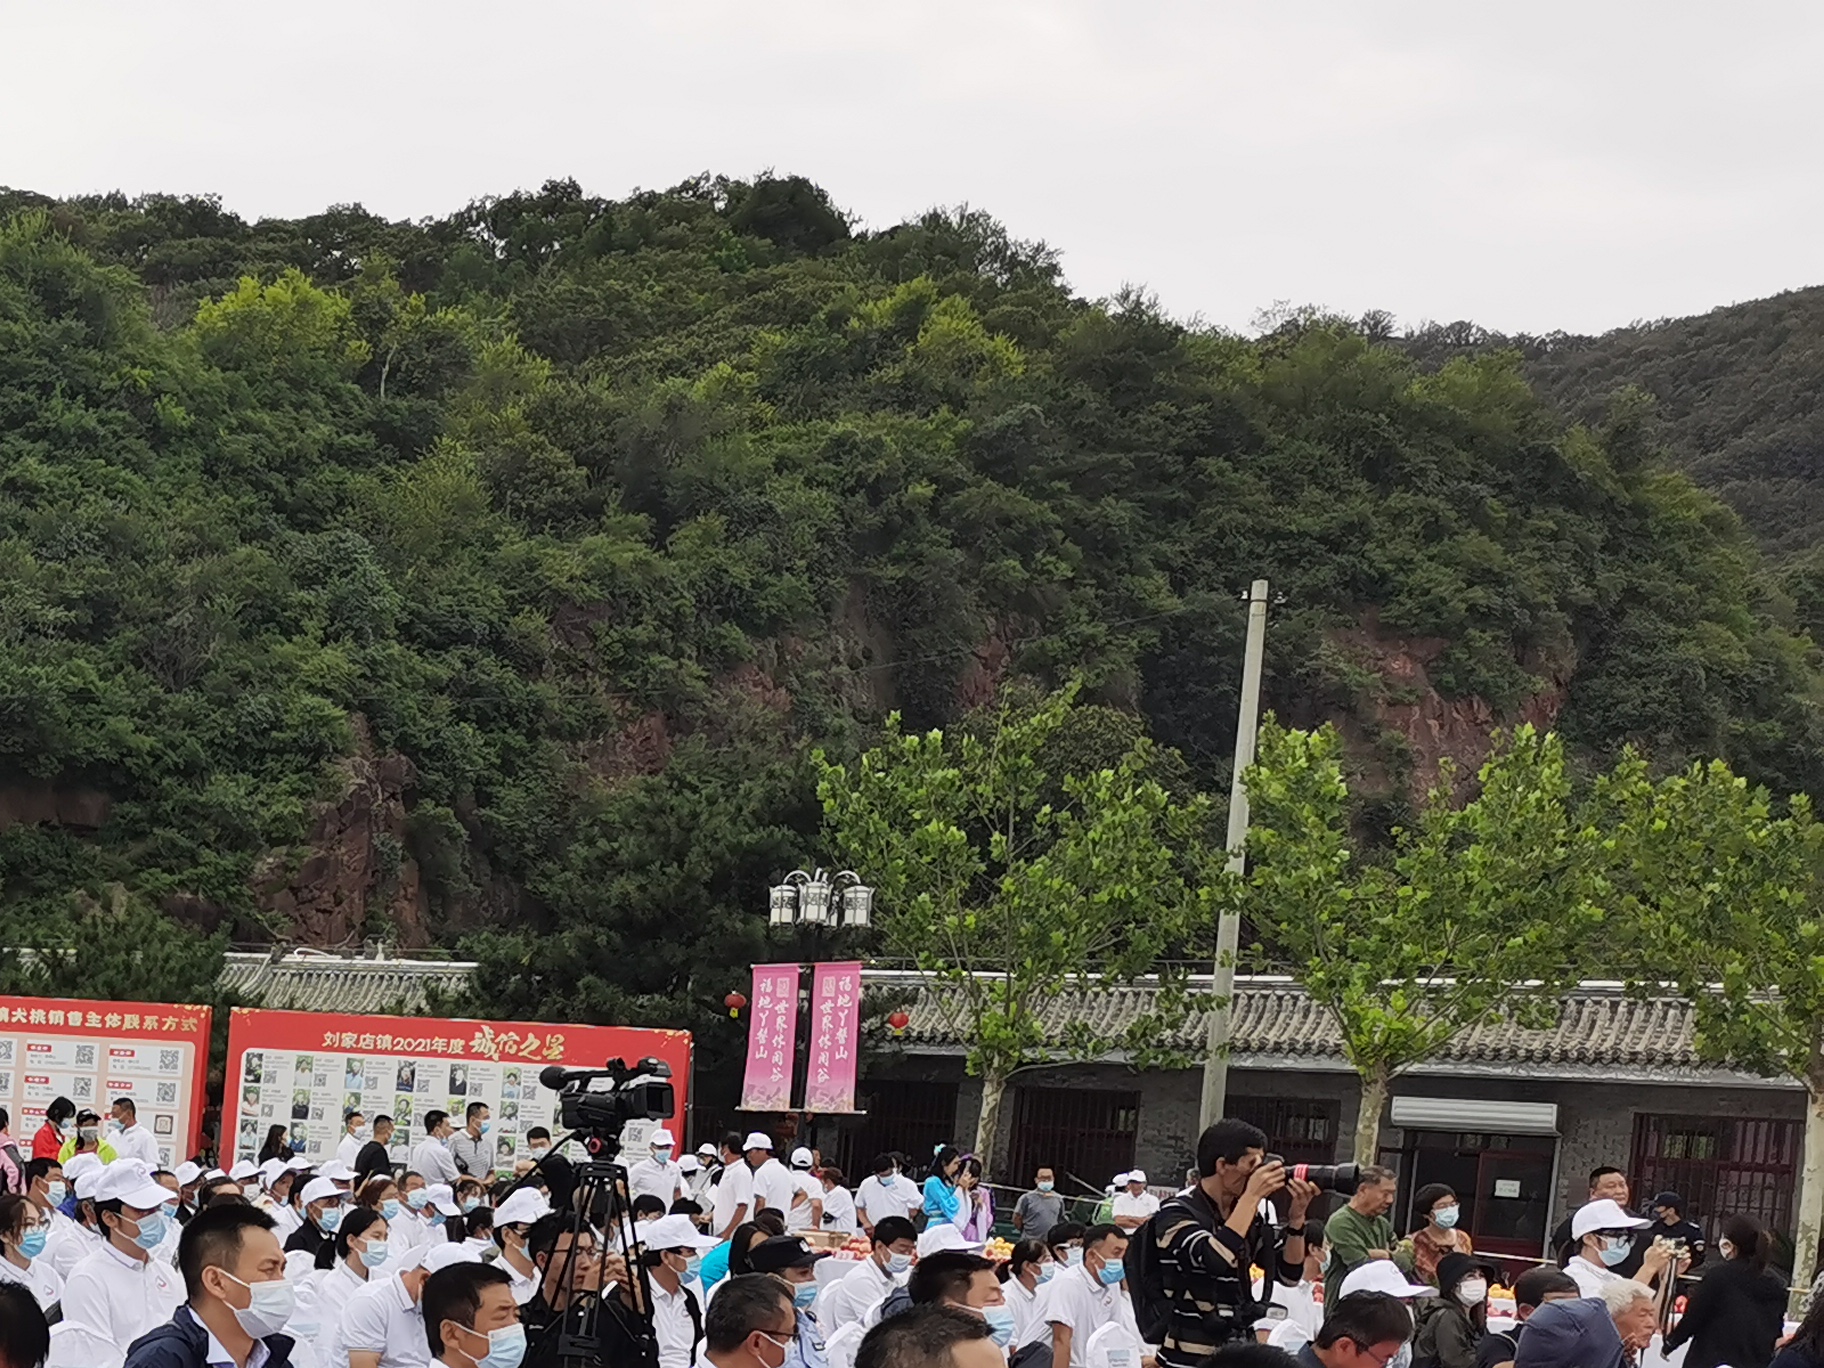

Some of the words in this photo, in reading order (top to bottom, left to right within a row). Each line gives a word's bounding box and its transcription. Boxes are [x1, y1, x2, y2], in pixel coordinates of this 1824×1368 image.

[322, 1031, 466, 1055] 刘家店镇2021年度
[468, 1024, 565, 1063] 诚信之星
[835, 976, 853, 1060] 福地丫髻山
